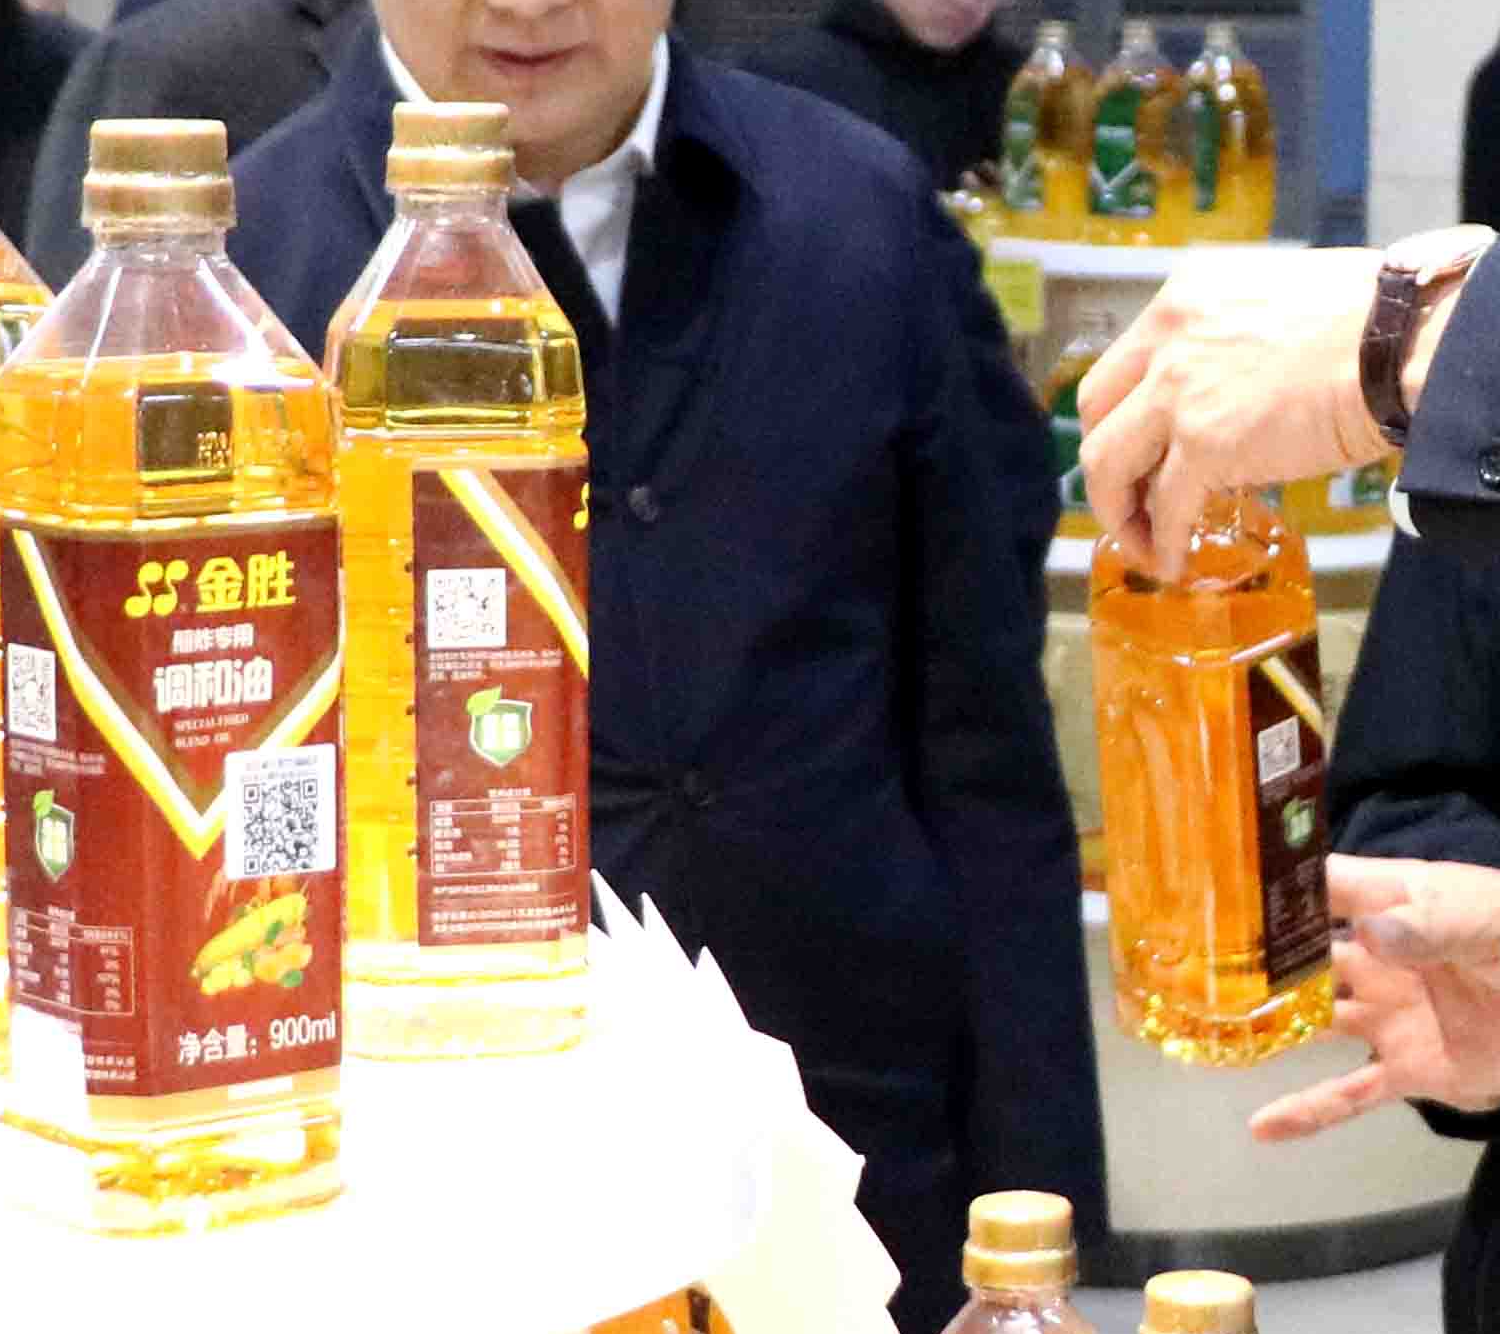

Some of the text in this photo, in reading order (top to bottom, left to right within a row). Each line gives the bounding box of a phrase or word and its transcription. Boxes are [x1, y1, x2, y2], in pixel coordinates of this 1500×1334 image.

[196, 550, 296, 612] 金胜
[154, 656, 274, 714] 调和油
[270, 1011, 337, 1050] 900ml
